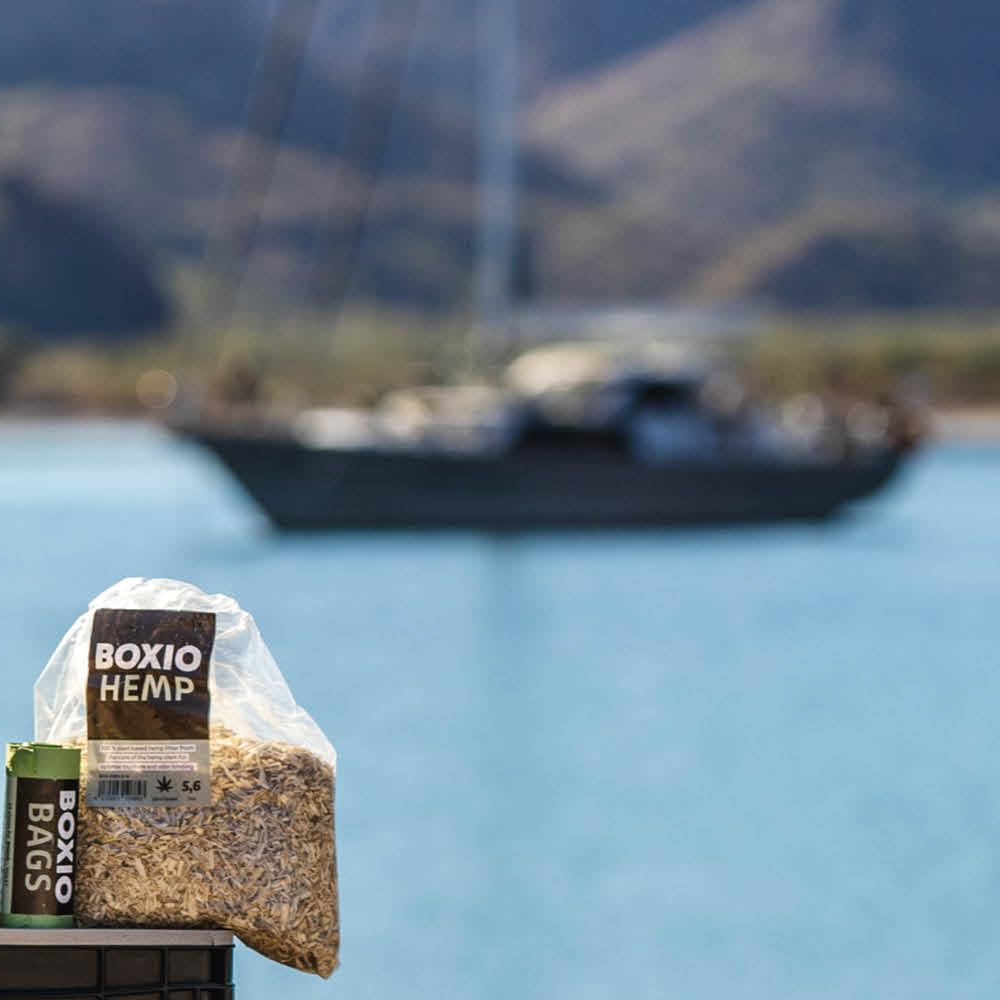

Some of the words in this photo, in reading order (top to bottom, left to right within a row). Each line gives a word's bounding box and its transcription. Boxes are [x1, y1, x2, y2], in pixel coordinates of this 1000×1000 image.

[95, 643, 202, 672] BOXIO
[101, 674, 195, 702] HEMP
[182, 780, 201, 793] 5,6
[25, 803, 55, 892] BAGS
[55, 790, 76, 904] BOXIO
